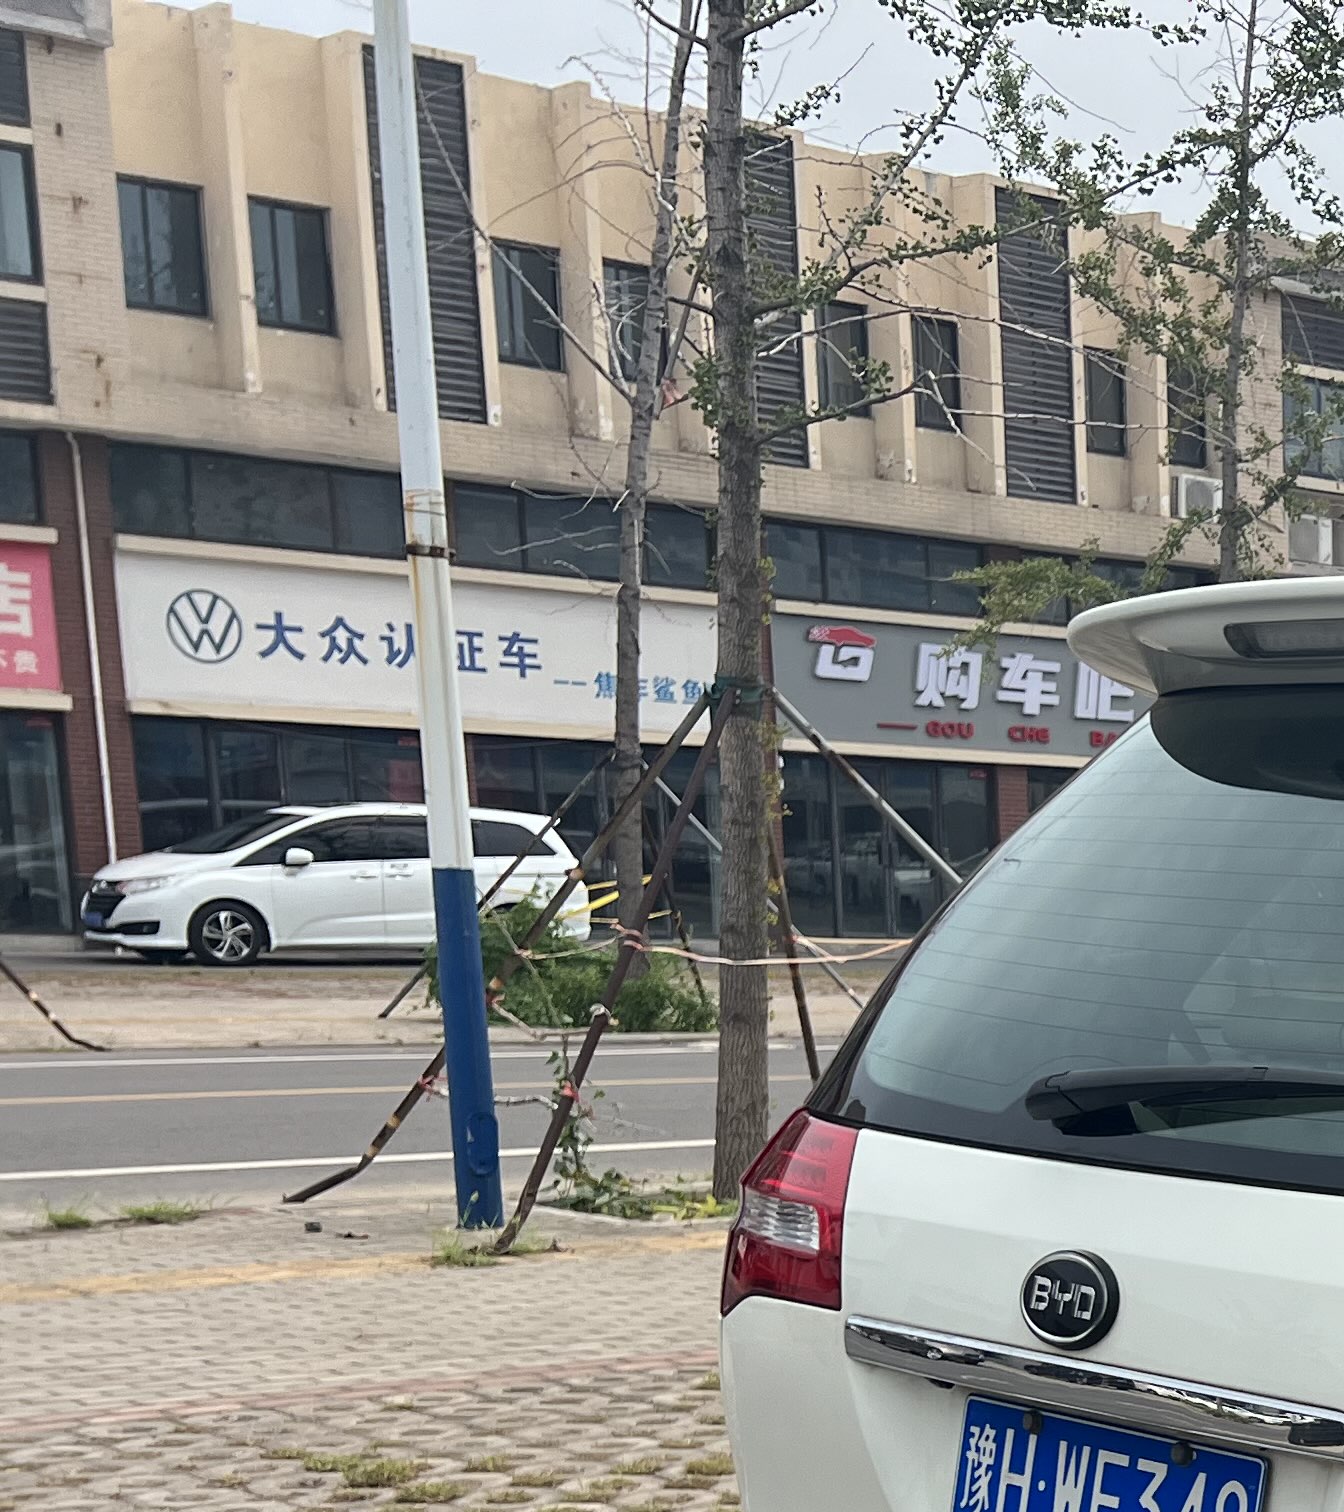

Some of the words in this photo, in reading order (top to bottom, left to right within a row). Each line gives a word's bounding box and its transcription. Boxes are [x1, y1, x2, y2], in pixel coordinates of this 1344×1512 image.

[925, 720, 976, 739] GOU
[1008, 724, 1051, 745] CHE
[1030, 1274, 1096, 1321] BYD
